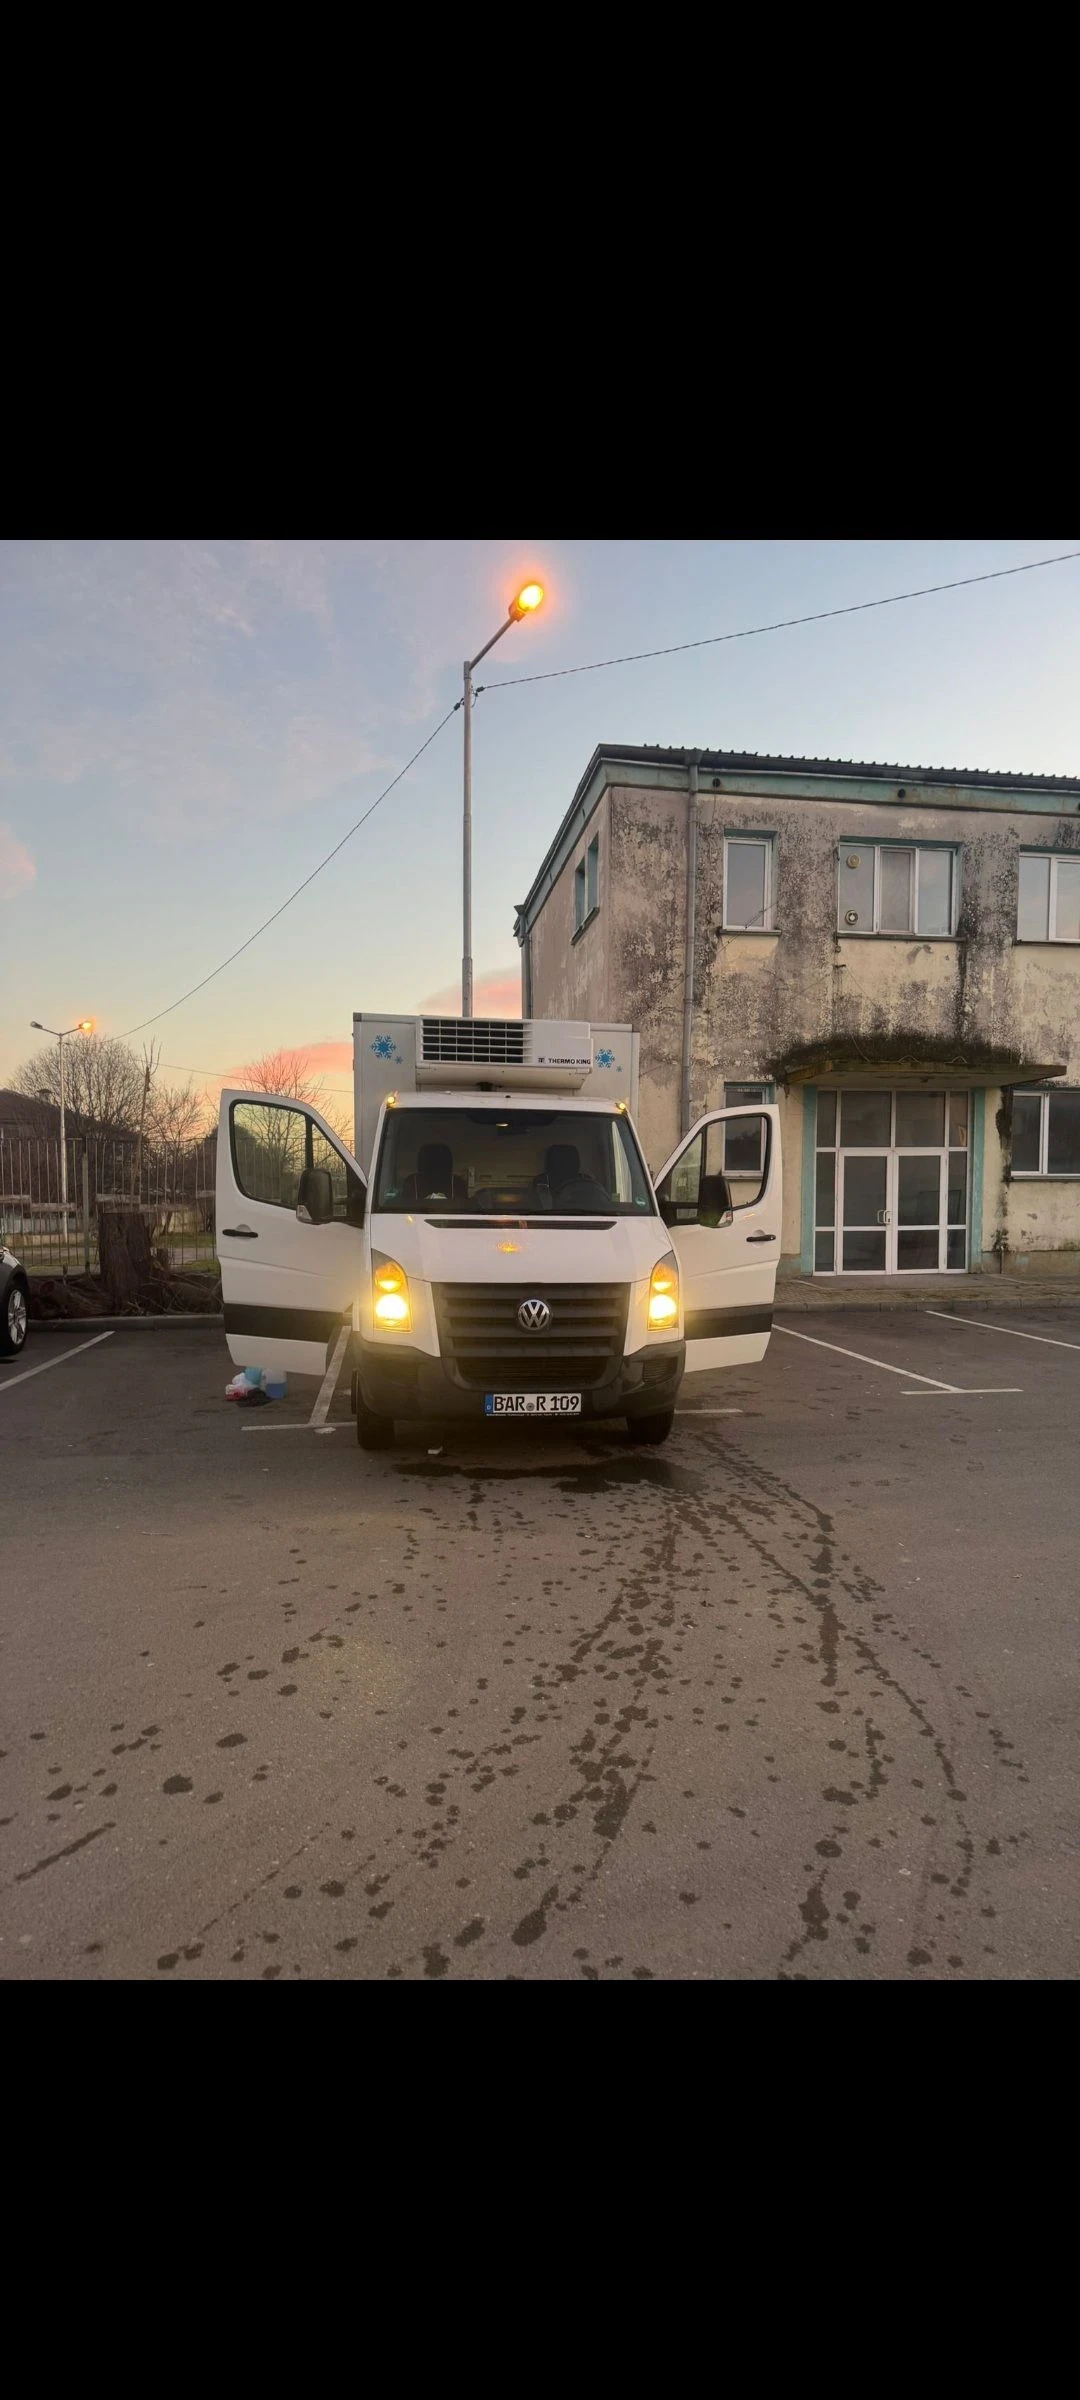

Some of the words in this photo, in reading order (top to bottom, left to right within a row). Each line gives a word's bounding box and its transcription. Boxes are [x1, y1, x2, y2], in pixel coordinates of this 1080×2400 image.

[494, 1396, 525, 1411] BAR
[536, 1396, 546, 1411] R
[550, 1396, 580, 1411] 109
